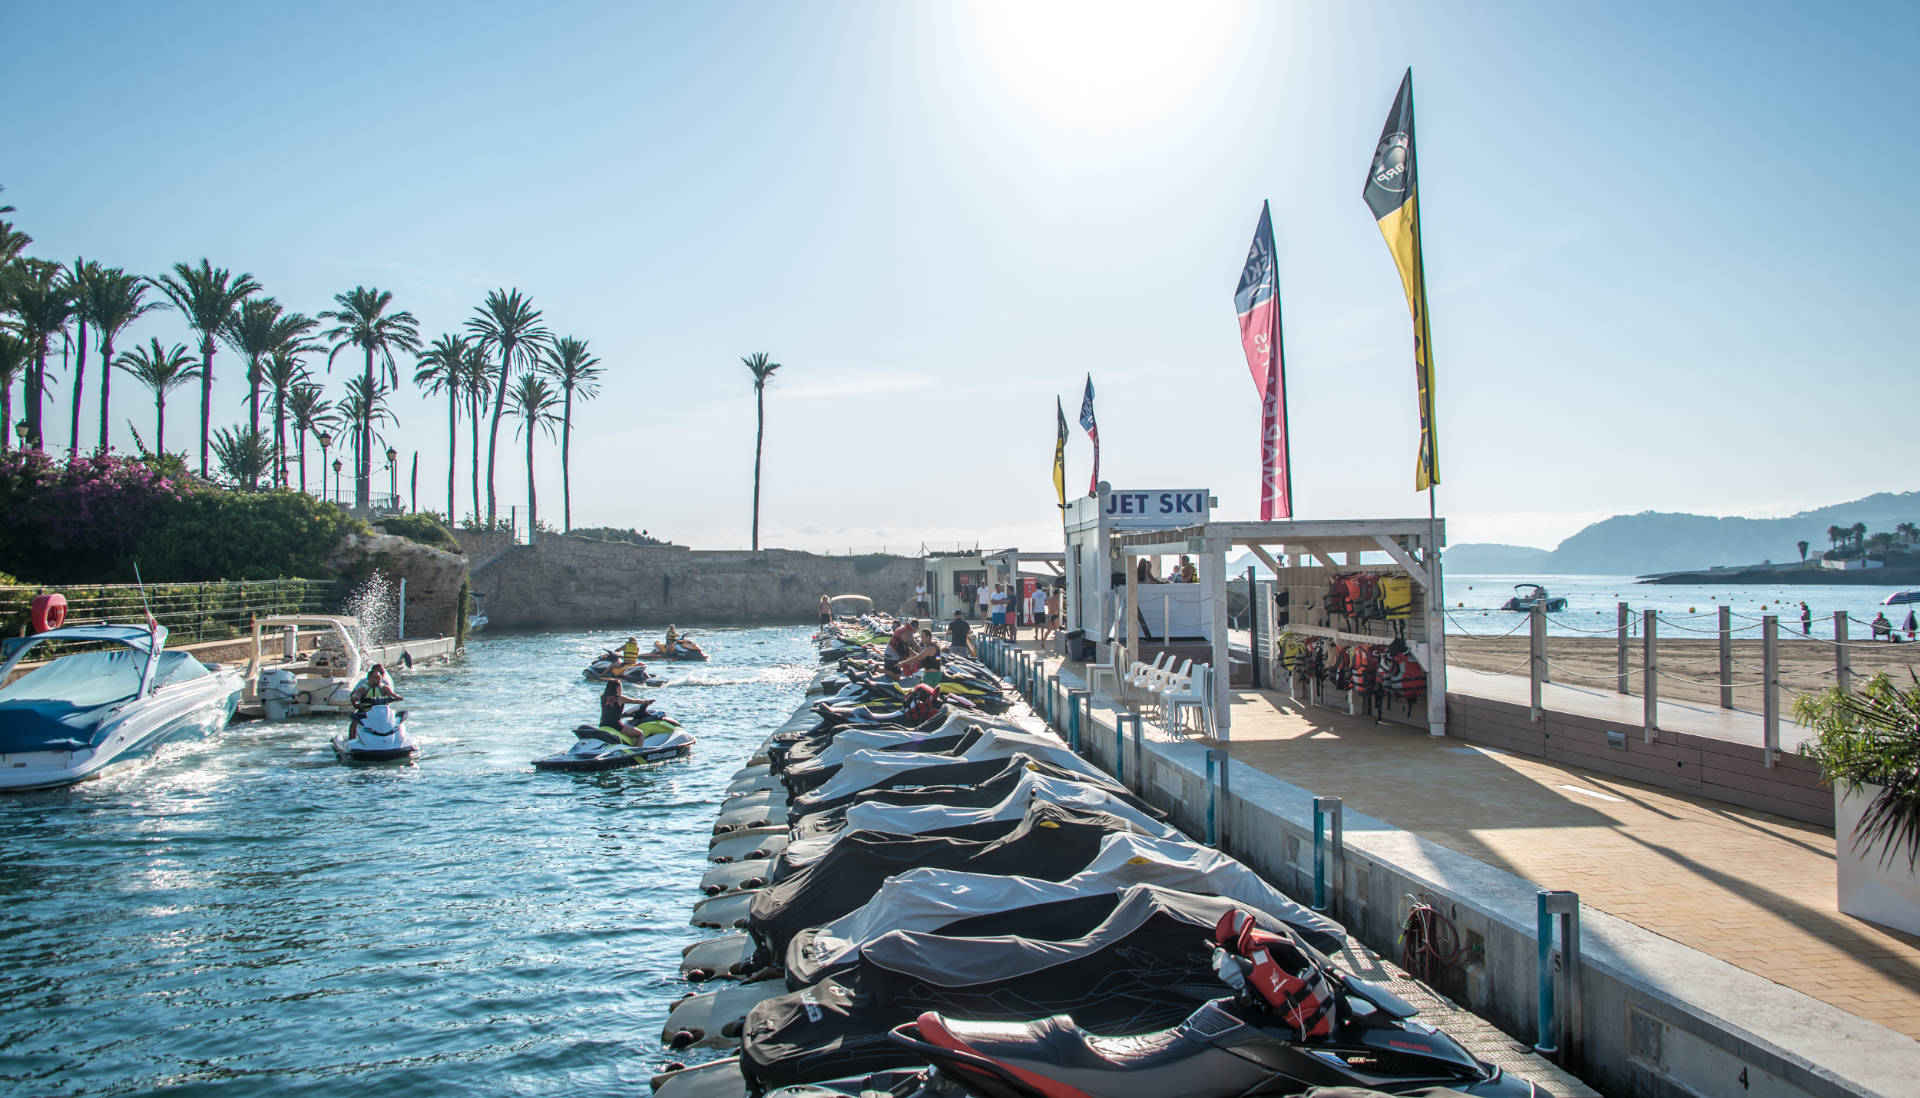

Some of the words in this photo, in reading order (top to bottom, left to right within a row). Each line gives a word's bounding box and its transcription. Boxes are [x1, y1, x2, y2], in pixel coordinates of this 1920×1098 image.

[1105, 494, 1148, 514] JET
[1159, 493, 1203, 514] SKI
[1451, 903, 1458, 921] 6
[1738, 1067, 1750, 1090] 4
